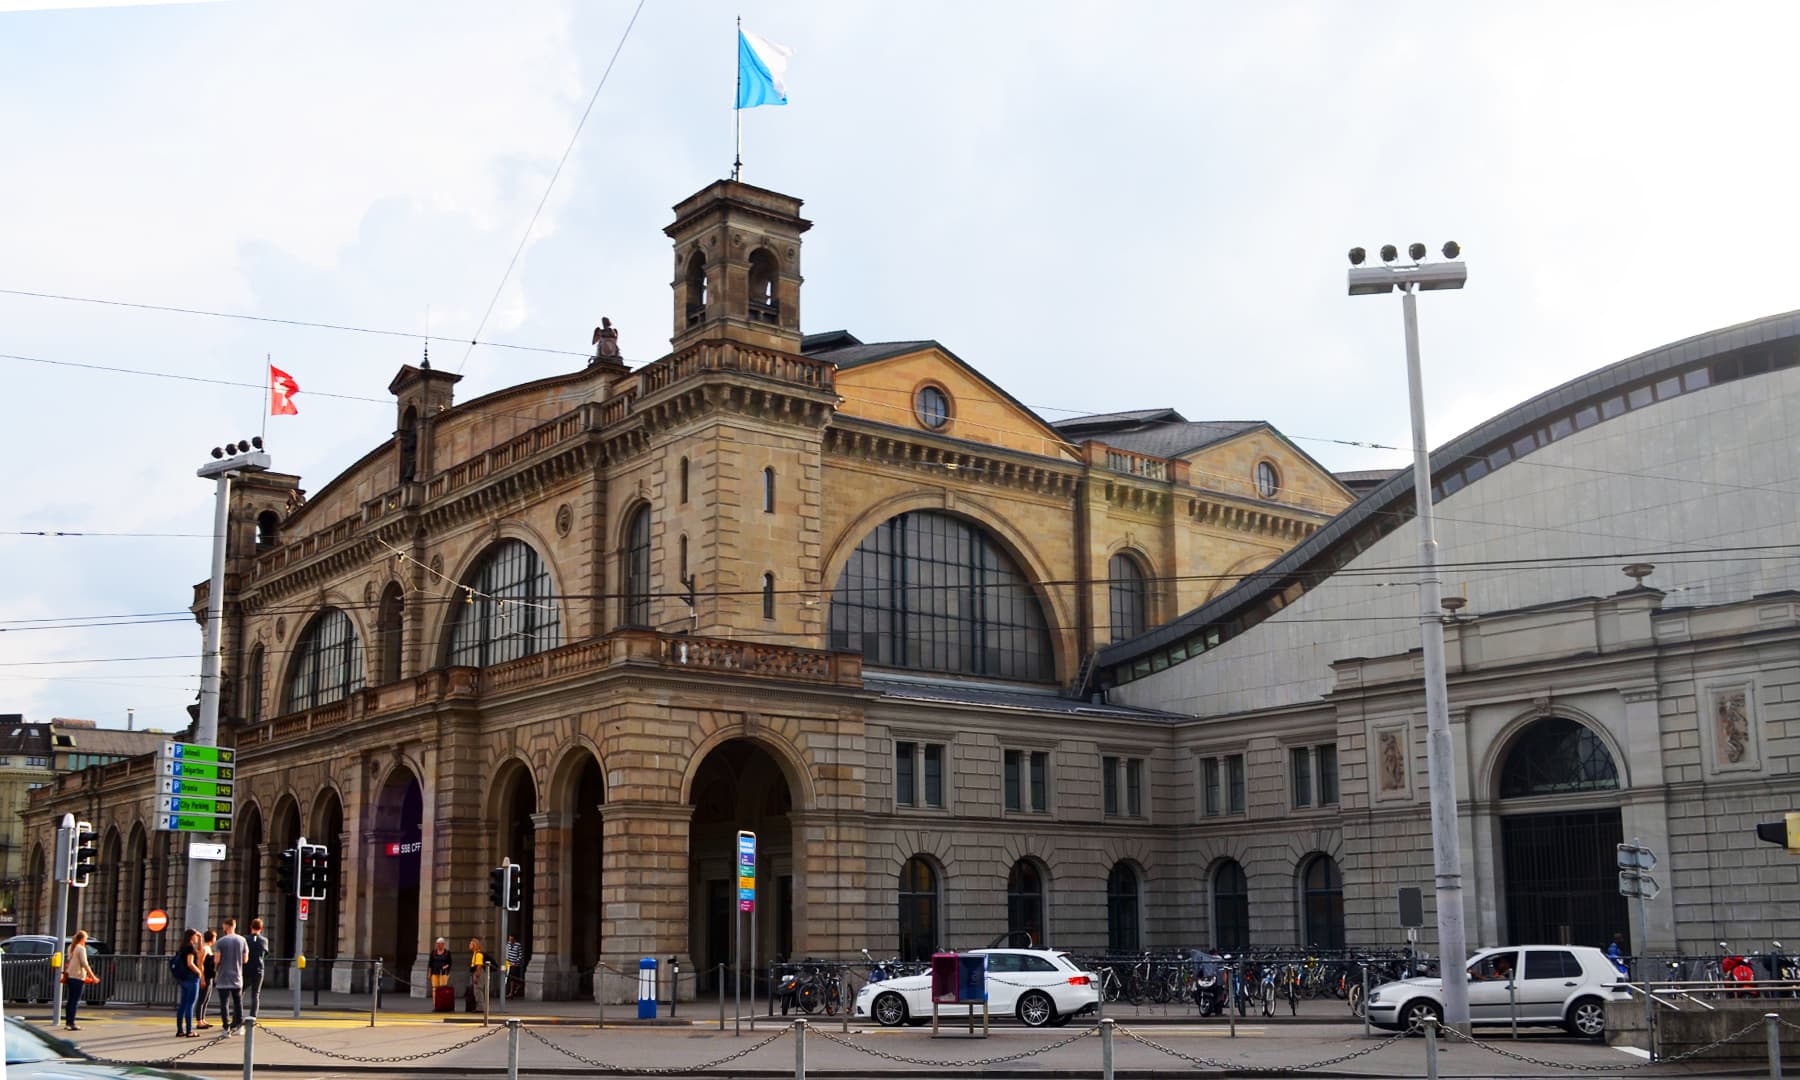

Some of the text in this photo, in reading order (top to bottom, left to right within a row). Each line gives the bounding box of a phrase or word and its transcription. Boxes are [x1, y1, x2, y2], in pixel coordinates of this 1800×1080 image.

[221, 769, 232, 777] 15
[182, 784, 198, 792] Urania
[181, 801, 190, 809] City
[191, 802, 209, 811] Parking
[216, 803, 231, 812] 300
